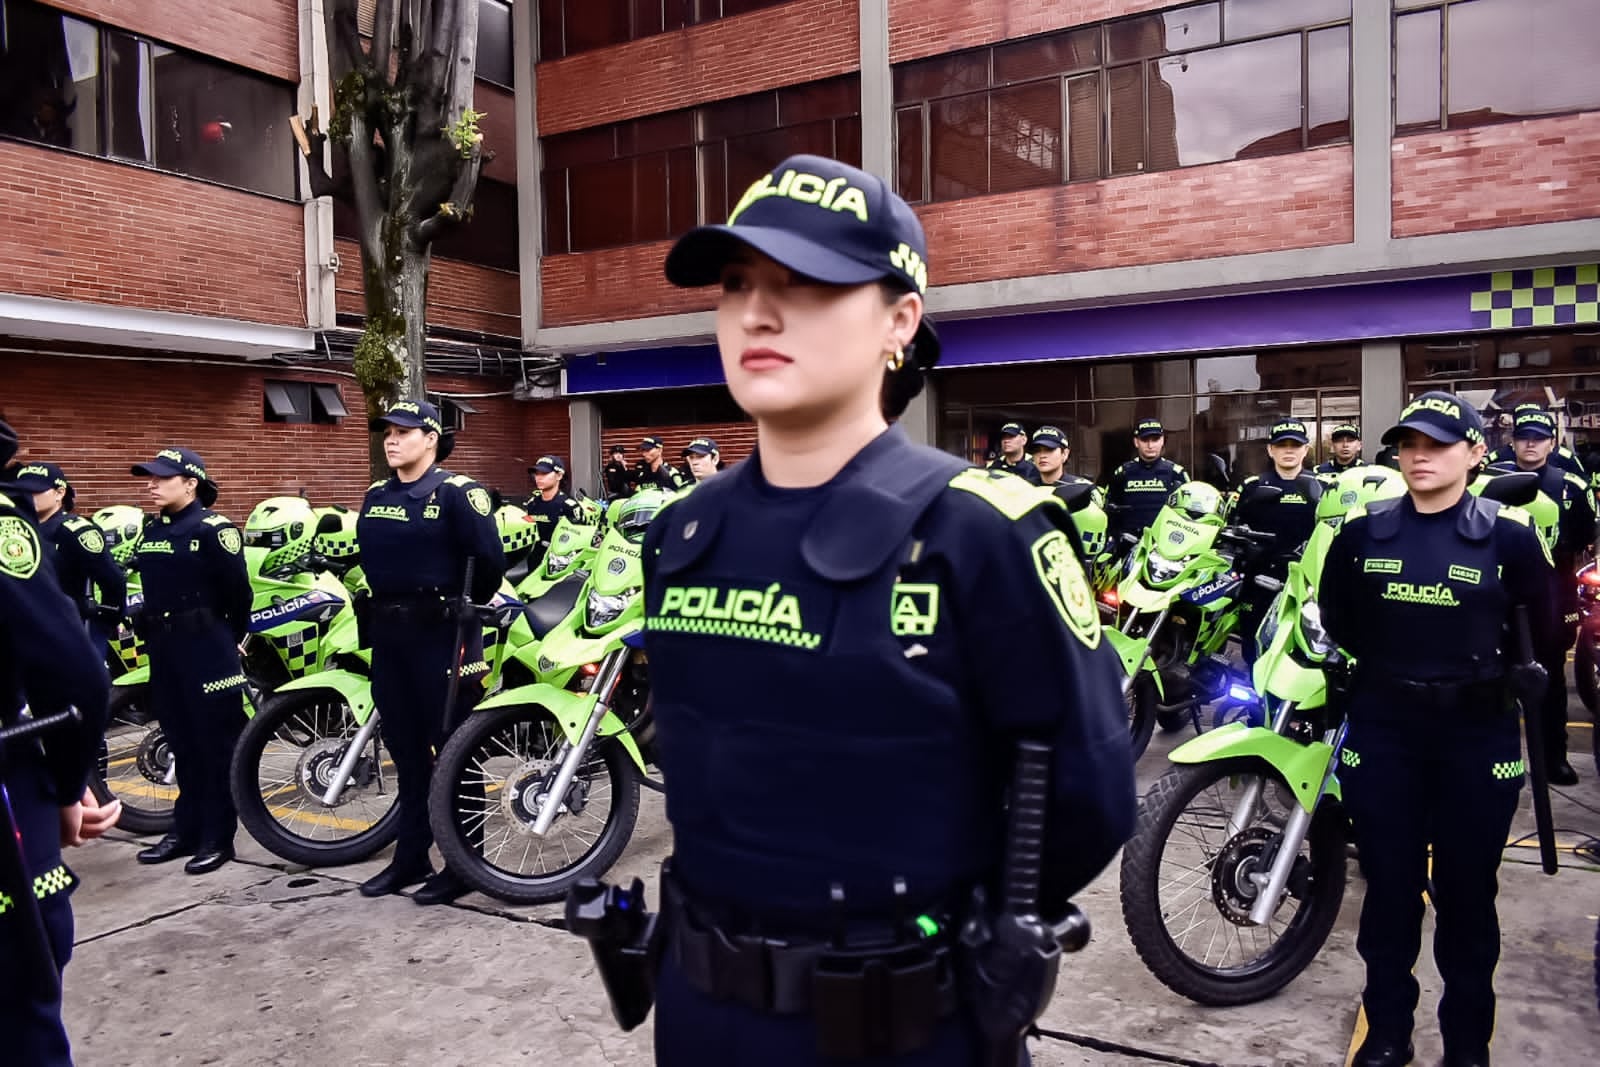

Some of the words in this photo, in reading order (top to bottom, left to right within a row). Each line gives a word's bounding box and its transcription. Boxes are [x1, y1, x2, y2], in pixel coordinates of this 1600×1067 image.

[607, 544, 642, 560] POLICÍ
[1387, 582, 1454, 602] POLICÍA
[249, 596, 312, 624] POLICÍA
[659, 582, 803, 630] POLICÍA
